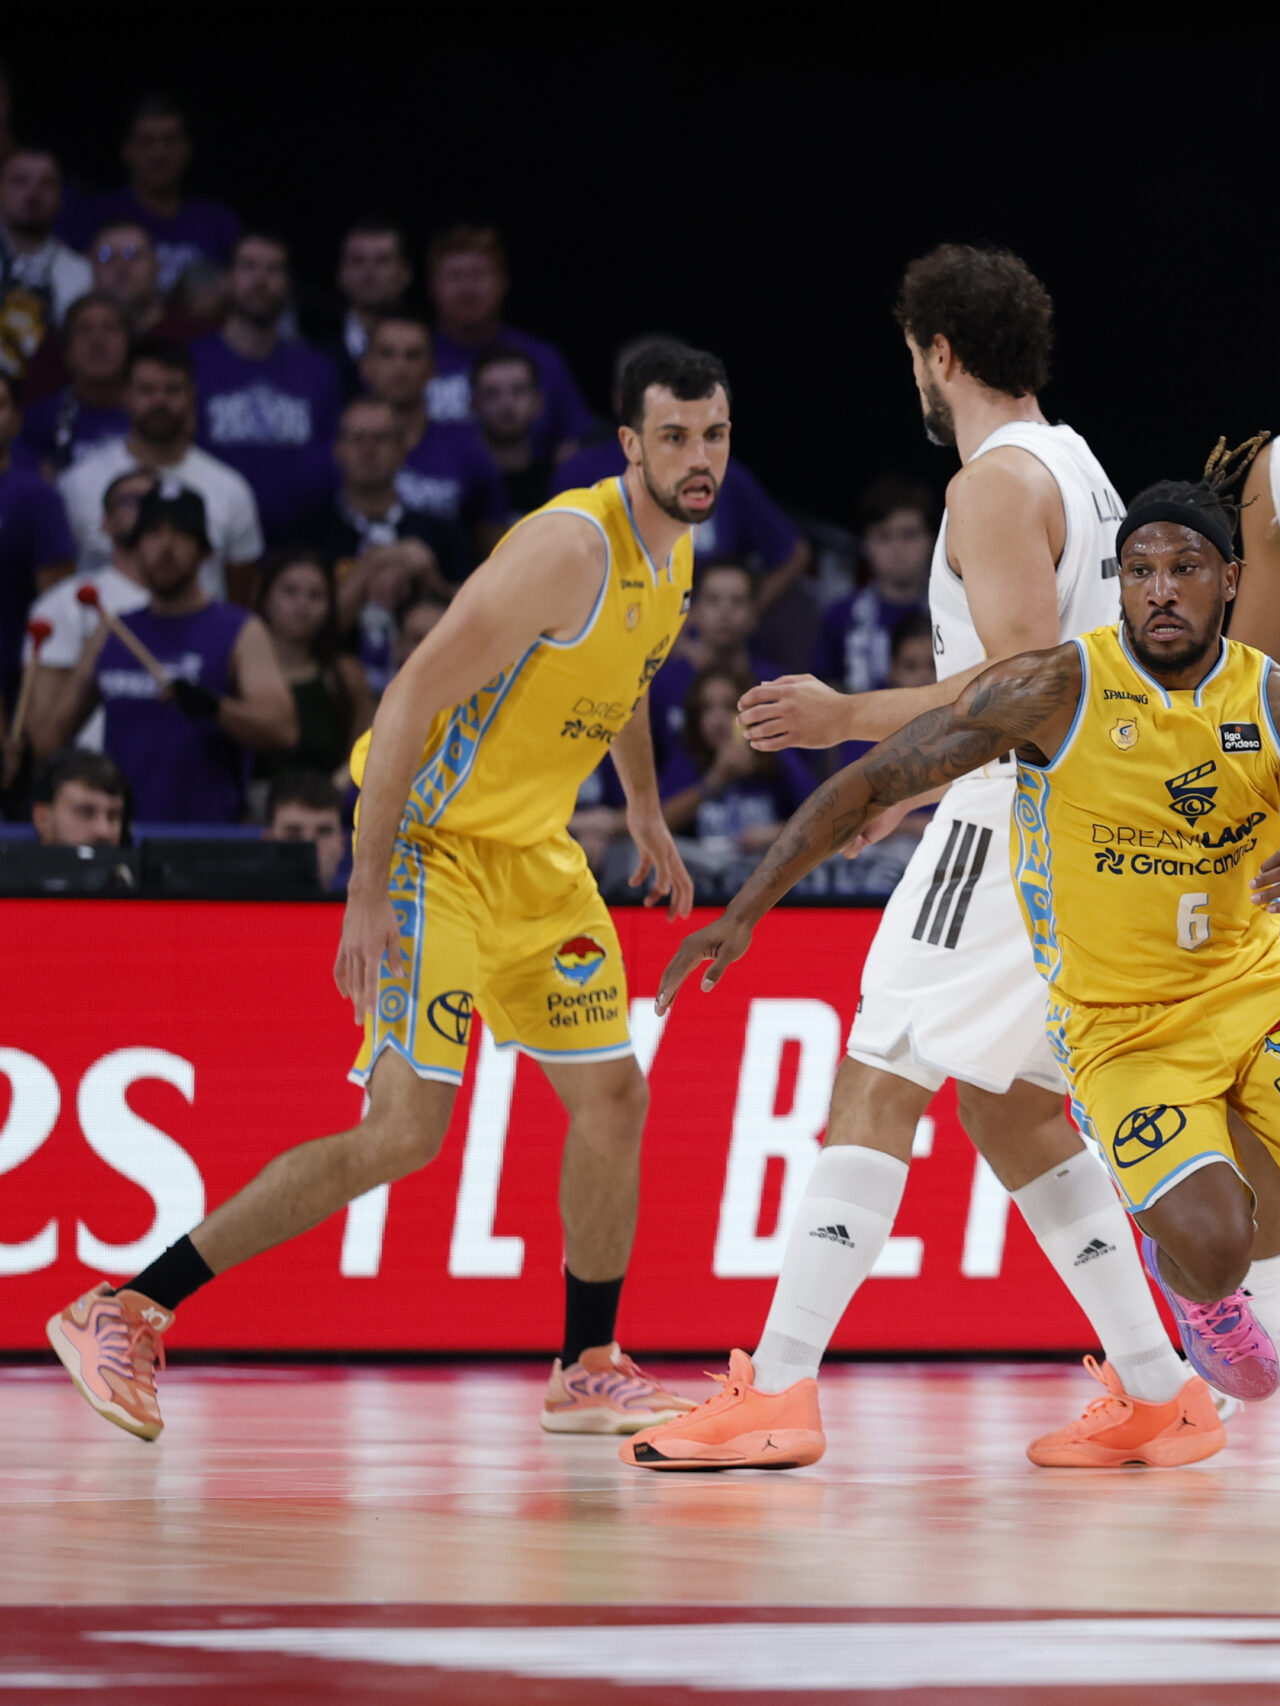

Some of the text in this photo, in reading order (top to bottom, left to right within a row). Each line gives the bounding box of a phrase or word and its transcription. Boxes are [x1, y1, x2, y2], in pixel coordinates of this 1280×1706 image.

[1224, 731, 1241, 742] liga
[1224, 739, 1260, 750] endesa
[1175, 892, 1212, 951] 6
[547, 985, 618, 1012] Poema
[549, 1010, 579, 1029] del
